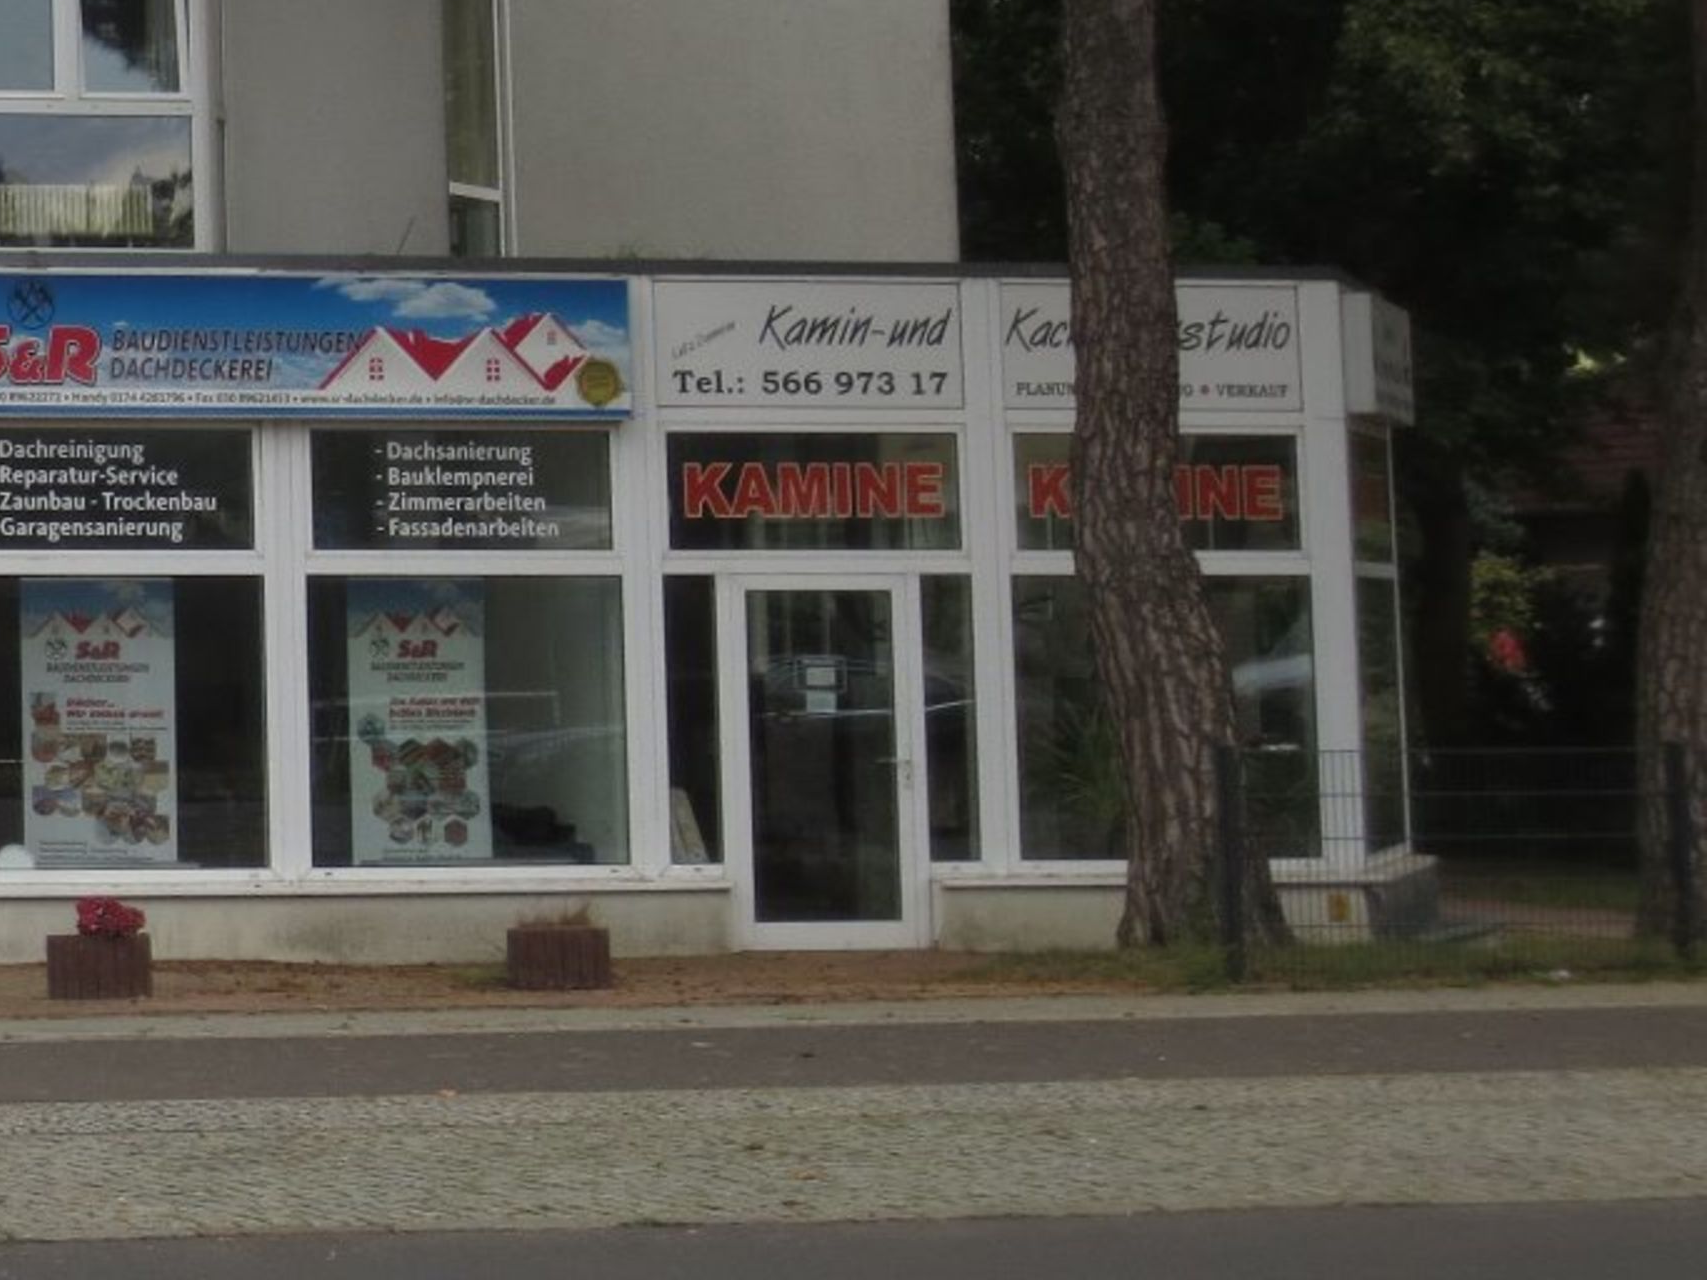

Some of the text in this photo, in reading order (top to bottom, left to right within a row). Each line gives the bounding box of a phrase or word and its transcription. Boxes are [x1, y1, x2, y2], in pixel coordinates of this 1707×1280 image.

[758, 304, 953, 351] Kamin-und
[1004, 307, 1292, 352] Kacstudio
[112, 329, 368, 353] BAUDIENSTLEISTUNGEN
[110, 357, 274, 381] DACHDECKEREI
[672, 370, 948, 395] Tel.: 566 973 17
[387, 441, 532, 466] Dachsanierung
[388, 467, 534, 491] Bauklempnerei
[682, 461, 946, 519] KAMINE
[102, 491, 217, 512] Trockenbau
[388, 493, 546, 512] Zimmerarbeiten
[1028, 463, 1285, 521] KINE
[388, 517, 560, 538] Fassadenarbeiten
